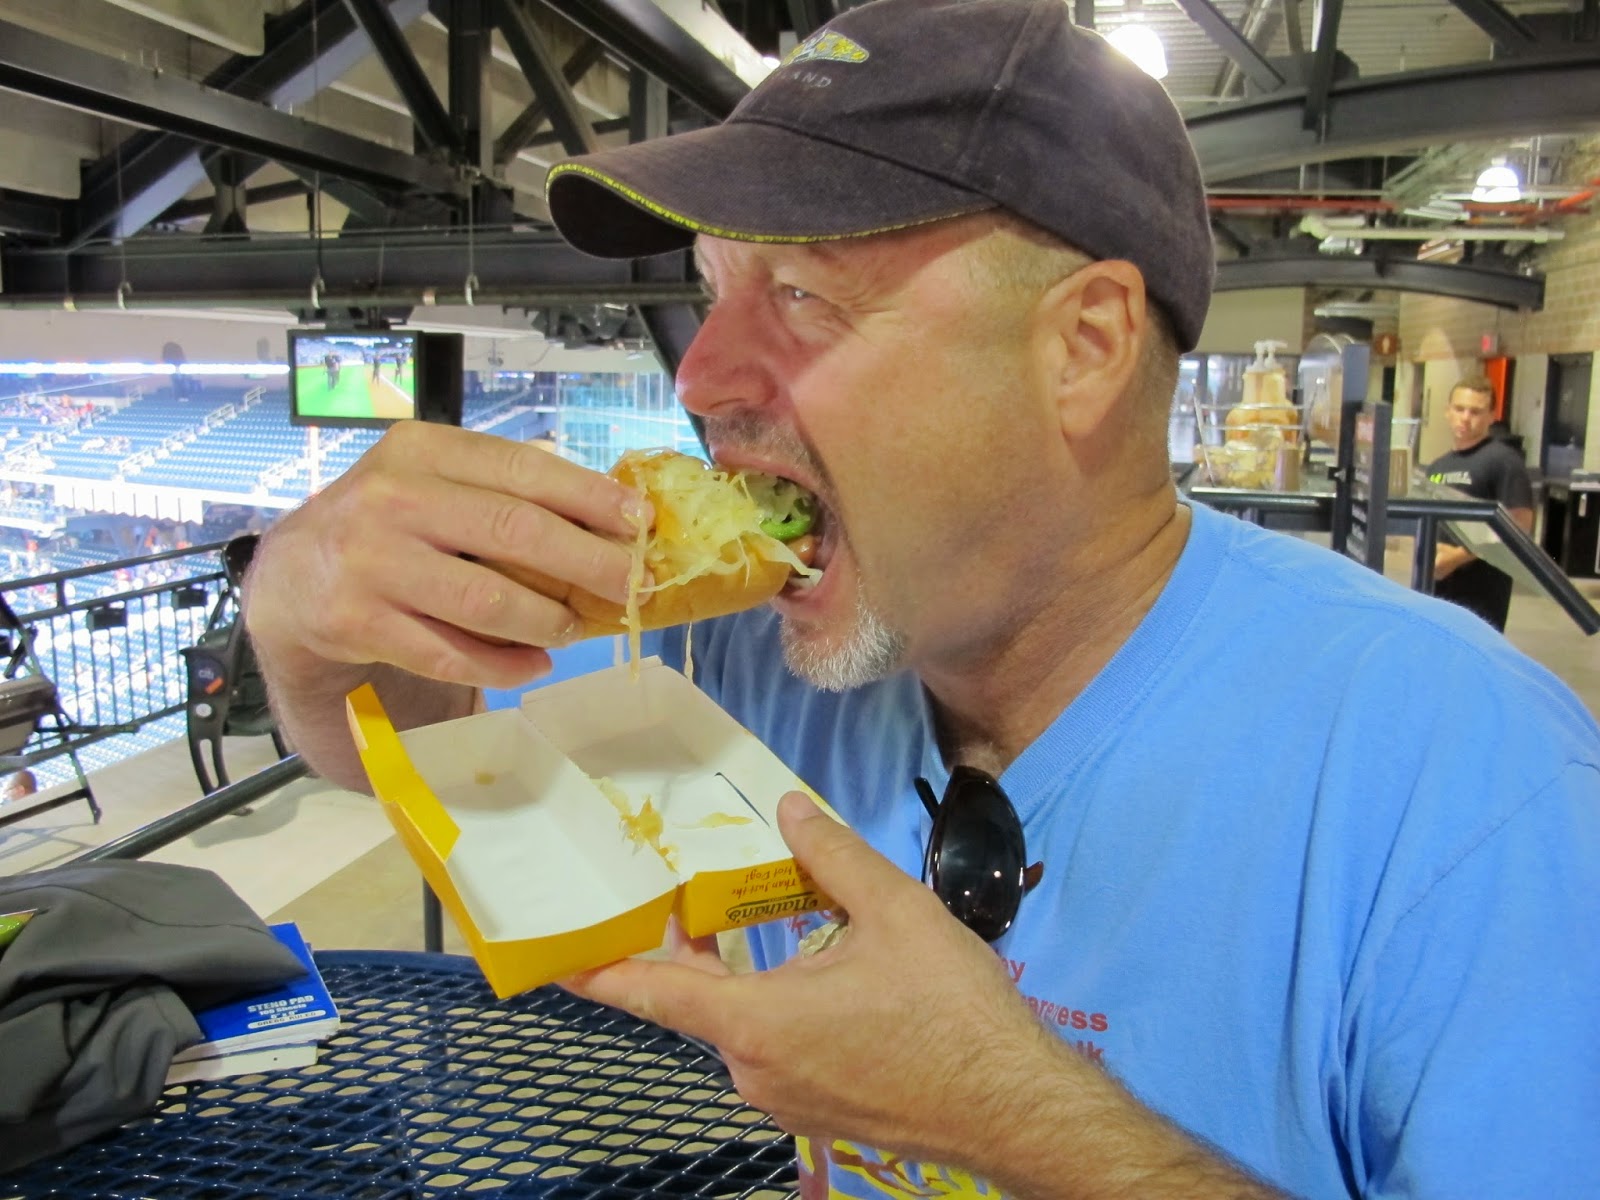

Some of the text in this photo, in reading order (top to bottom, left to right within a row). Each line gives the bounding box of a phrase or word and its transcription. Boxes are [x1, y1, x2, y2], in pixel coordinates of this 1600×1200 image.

[727, 896, 818, 923] Nathan's
[247, 995, 315, 1013] STENO PAD
[276, 1003, 307, 1013] Sheets
